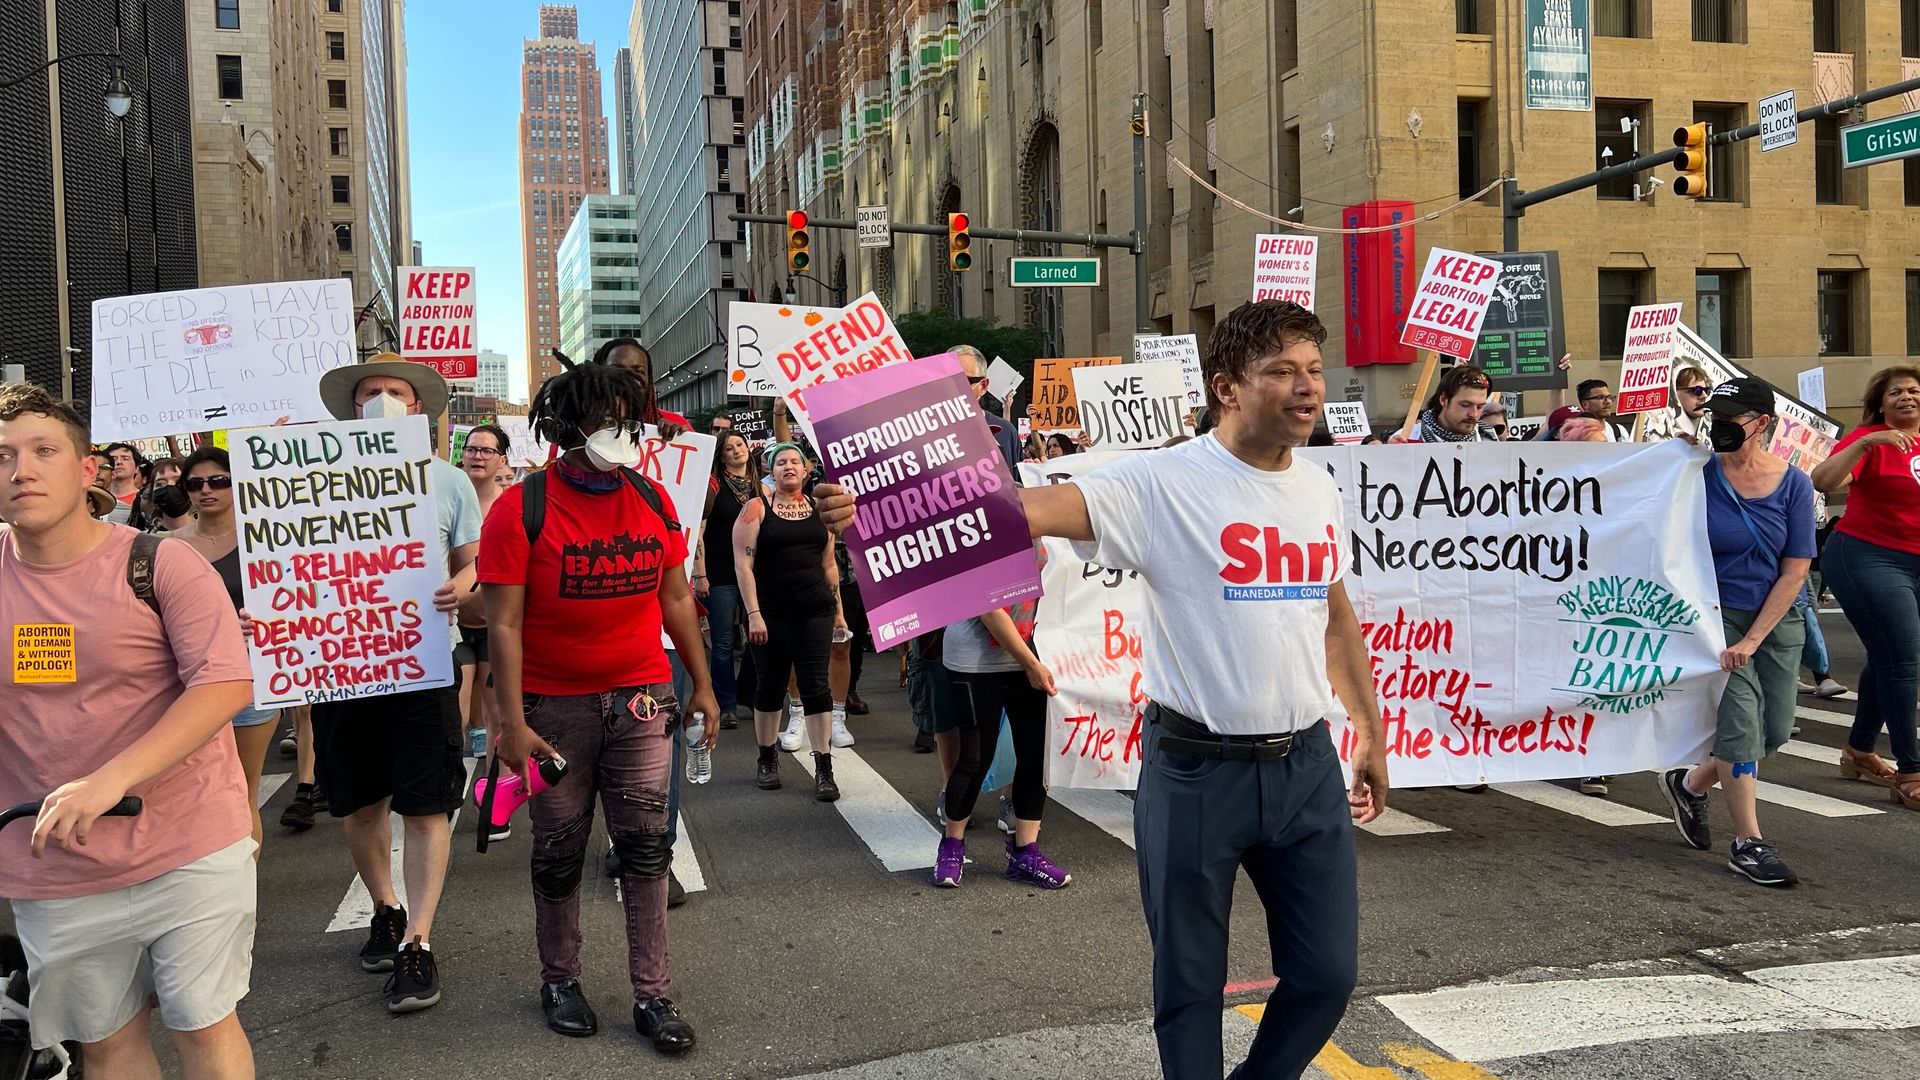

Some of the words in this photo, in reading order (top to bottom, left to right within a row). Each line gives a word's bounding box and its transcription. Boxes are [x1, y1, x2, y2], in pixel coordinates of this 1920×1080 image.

[1533, 26, 1583, 45] AVAILABLE
[1761, 104, 1773, 118] DO
[1776, 97, 1794, 112] NOT
[1762, 115, 1795, 135] BLOCK
[1763, 130, 1795, 146] INTERSECTION
[1866, 127, 1920, 152] Grisw
[859, 212, 869, 221] DO
[872, 211, 886, 221] NOT
[860, 224, 887, 235] BLOCK
[1259, 239, 1314, 255] DEFEND
[1034, 266, 1077, 279] Larned
[1258, 260, 1300, 271] WOMEN'S
[1303, 261, 1309, 271] &
[1432, 255, 1495, 286] KEEP
[1506, 264, 1521, 272] OFF
[407, 272, 470, 299] KEEP
[1257, 275, 1310, 284] REPRODUCTIVE
[1257, 289, 1310, 306] RIGHTS
[1422, 281, 1488, 306] ABORTION
[97, 295, 197, 332] FORCED
[207, 291, 228, 316] 2
[251, 284, 339, 313] HAVE
[402, 305, 473, 319] ABORTION
[1413, 298, 1479, 333] LEGAL
[1630, 308, 1678, 329] DEFEND
[97, 329, 168, 366] THE
[253, 313, 320, 342] KIDS
[331, 313, 350, 336] U
[403, 325, 472, 350] LEGAL
[776, 301, 885, 382] DEFEND
[1628, 334, 1664, 347] WOMEN'S
[1666, 332, 1672, 343] &
[1625, 350, 1670, 363] REPRODUCTIVE
[93, 364, 152, 407] LET
[168, 352, 225, 395] DIE
[240, 367, 255, 382] in
[1103, 376, 1144, 396] WE
[1623, 365, 1669, 388] RIGHTS
[1038, 384, 1069, 405] AID
[120, 414, 149, 429] PRO
[159, 408, 203, 423] BIRTH
[231, 402, 258, 416] PRO
[263, 399, 295, 411] LIFE
[735, 410, 762, 421] DON'T
[1080, 395, 1183, 447] DISSENT
[1329, 406, 1359, 415] ABORT
[1337, 416, 1355, 425] THE
[1785, 404, 1827, 432] HYENAS
[827, 394, 976, 469] REPRODUCTIVE
[1333, 425, 1363, 434] COURT
[1783, 418, 1811, 445] YOU
[246, 431, 342, 470] BUILD
[349, 431, 398, 456] THE
[838, 450, 920, 498] RIGHTS
[923, 433, 965, 469] ARE
[238, 458, 432, 515] INDEPENDENT
[854, 449, 1002, 541] WORKERS'
[1358, 461, 1404, 523] to
[1413, 456, 1602, 519] Abortion
[244, 502, 416, 553] MOVEMENT
[864, 507, 992, 583] RIGHTS!
[1219, 522, 1339, 584] Shri
[1350, 525, 1589, 582] Necessary!
[248, 559, 283, 589] NO
[290, 542, 426, 582] RELIANCE
[565, 549, 662, 576] BAMN
[271, 581, 318, 611] ON
[329, 579, 389, 607] THE
[1227, 588, 1284, 599] THANEDAR
[1286, 589, 1297, 598] for
[1556, 585, 1584, 615] BY
[1588, 575, 1632, 602] ANY
[1630, 578, 1700, 626] MEANS
[250, 600, 422, 648] DEMOCRATS
[893, 612, 918, 626] MICHIGAN
[1580, 597, 1679, 628] NECESSARY
[18, 627, 71, 637] ABORTION
[896, 621, 920, 637] AFL-CIO
[18, 639, 30, 647] ON
[34, 639, 71, 647] DEMAND
[18, 650, 25, 658] &
[29, 650, 71, 658] WITHOUT
[261, 645, 304, 669] TO
[319, 630, 422, 662] DEFEND
[1572, 626, 1669, 662] JOIN
[17, 660, 72, 670] APOLOGY!
[269, 664, 333, 695] OUR
[332, 656, 425, 688] RIGHTS
[1568, 658, 1683, 692] BAMN
[305, 682, 396, 705] BAMN.COM
[1060, 711, 1116, 762] The
[1440, 706, 1595, 757] Streets!
